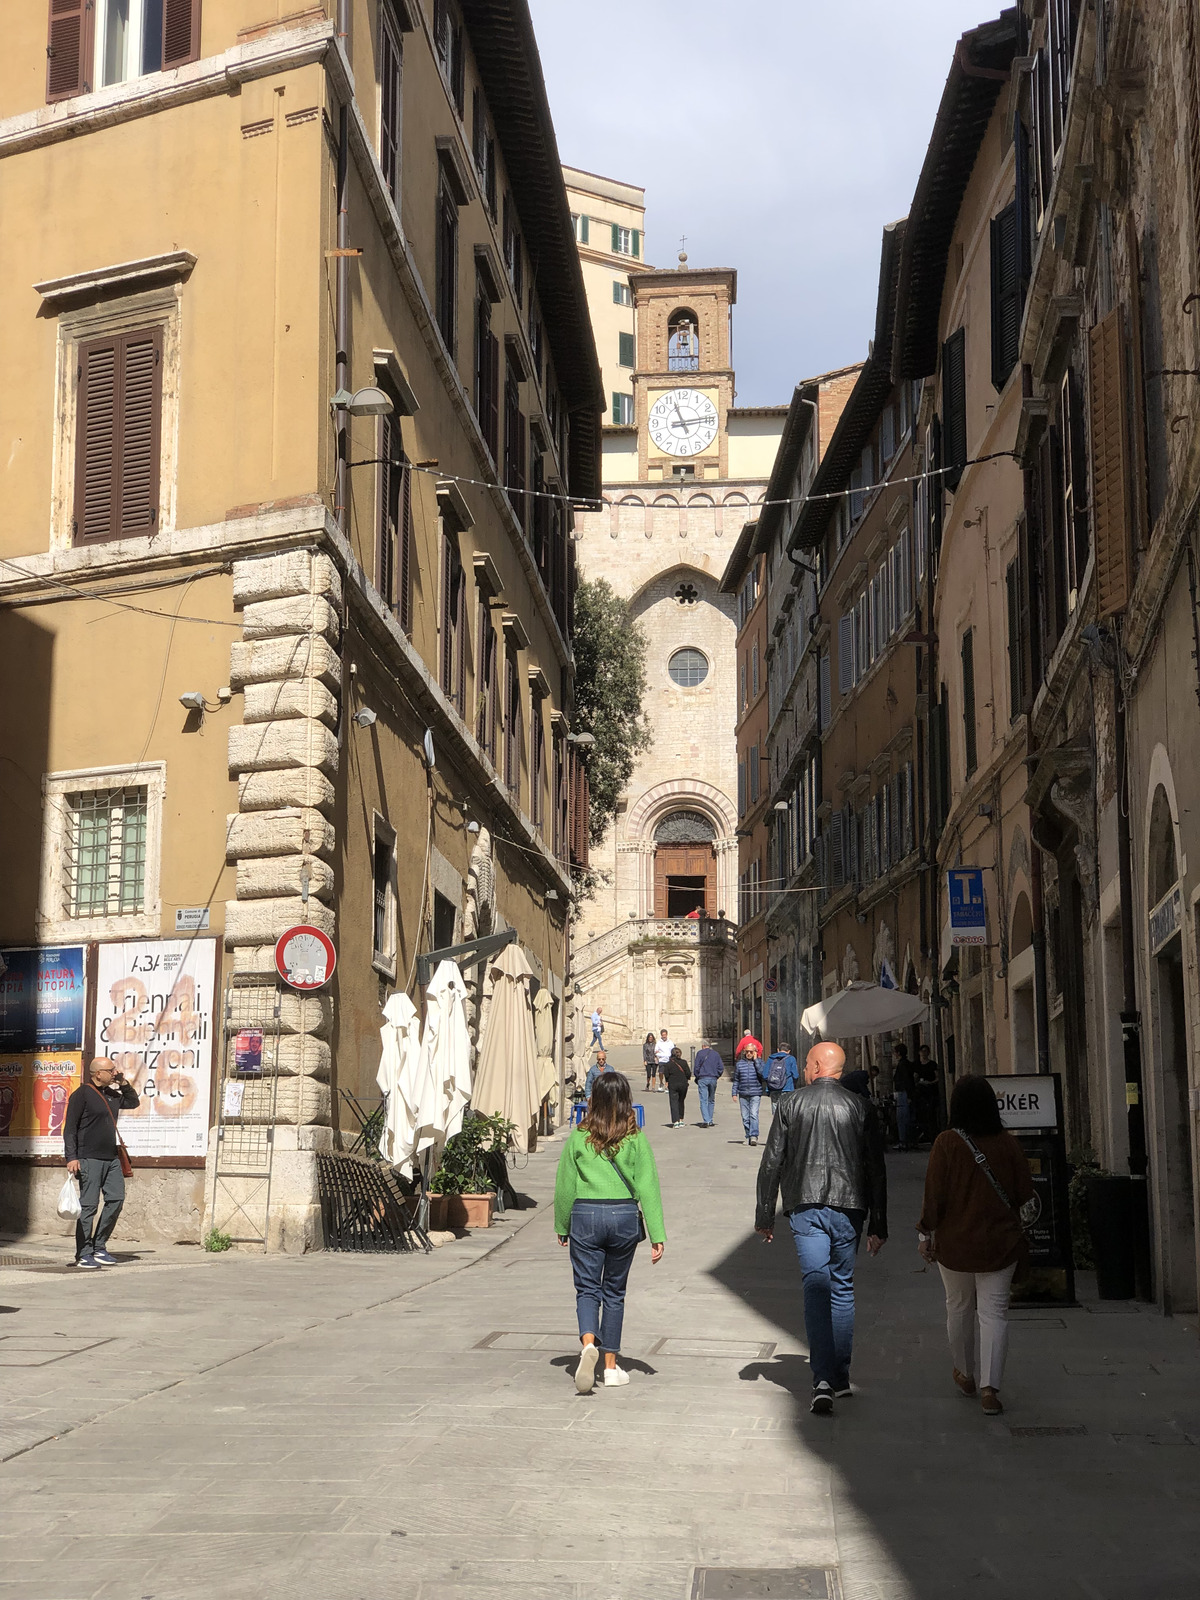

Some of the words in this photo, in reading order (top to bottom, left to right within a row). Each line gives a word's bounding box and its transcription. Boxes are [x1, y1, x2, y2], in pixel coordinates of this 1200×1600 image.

[678, 391, 688, 399] 12
[665, 396, 672, 404] 11
[655, 405, 665, 414] 10
[704, 403, 711, 412] 2
[652, 419, 659, 428] 9
[655, 432, 662, 442] 8
[705, 430, 712, 440] 4
[666, 442, 672, 451] 7
[680, 445, 687, 454] 6
[694, 441, 701, 450] 5
[37, 969, 75, 980] NATURA
[37, 981, 75, 992] UTOPIA
[109, 984, 201, 1015] Triennali
[100, 1016, 116, 1043] &
[124, 1011, 207, 1042] Biennali
[996, 1094, 1039, 1110] OKÉR
